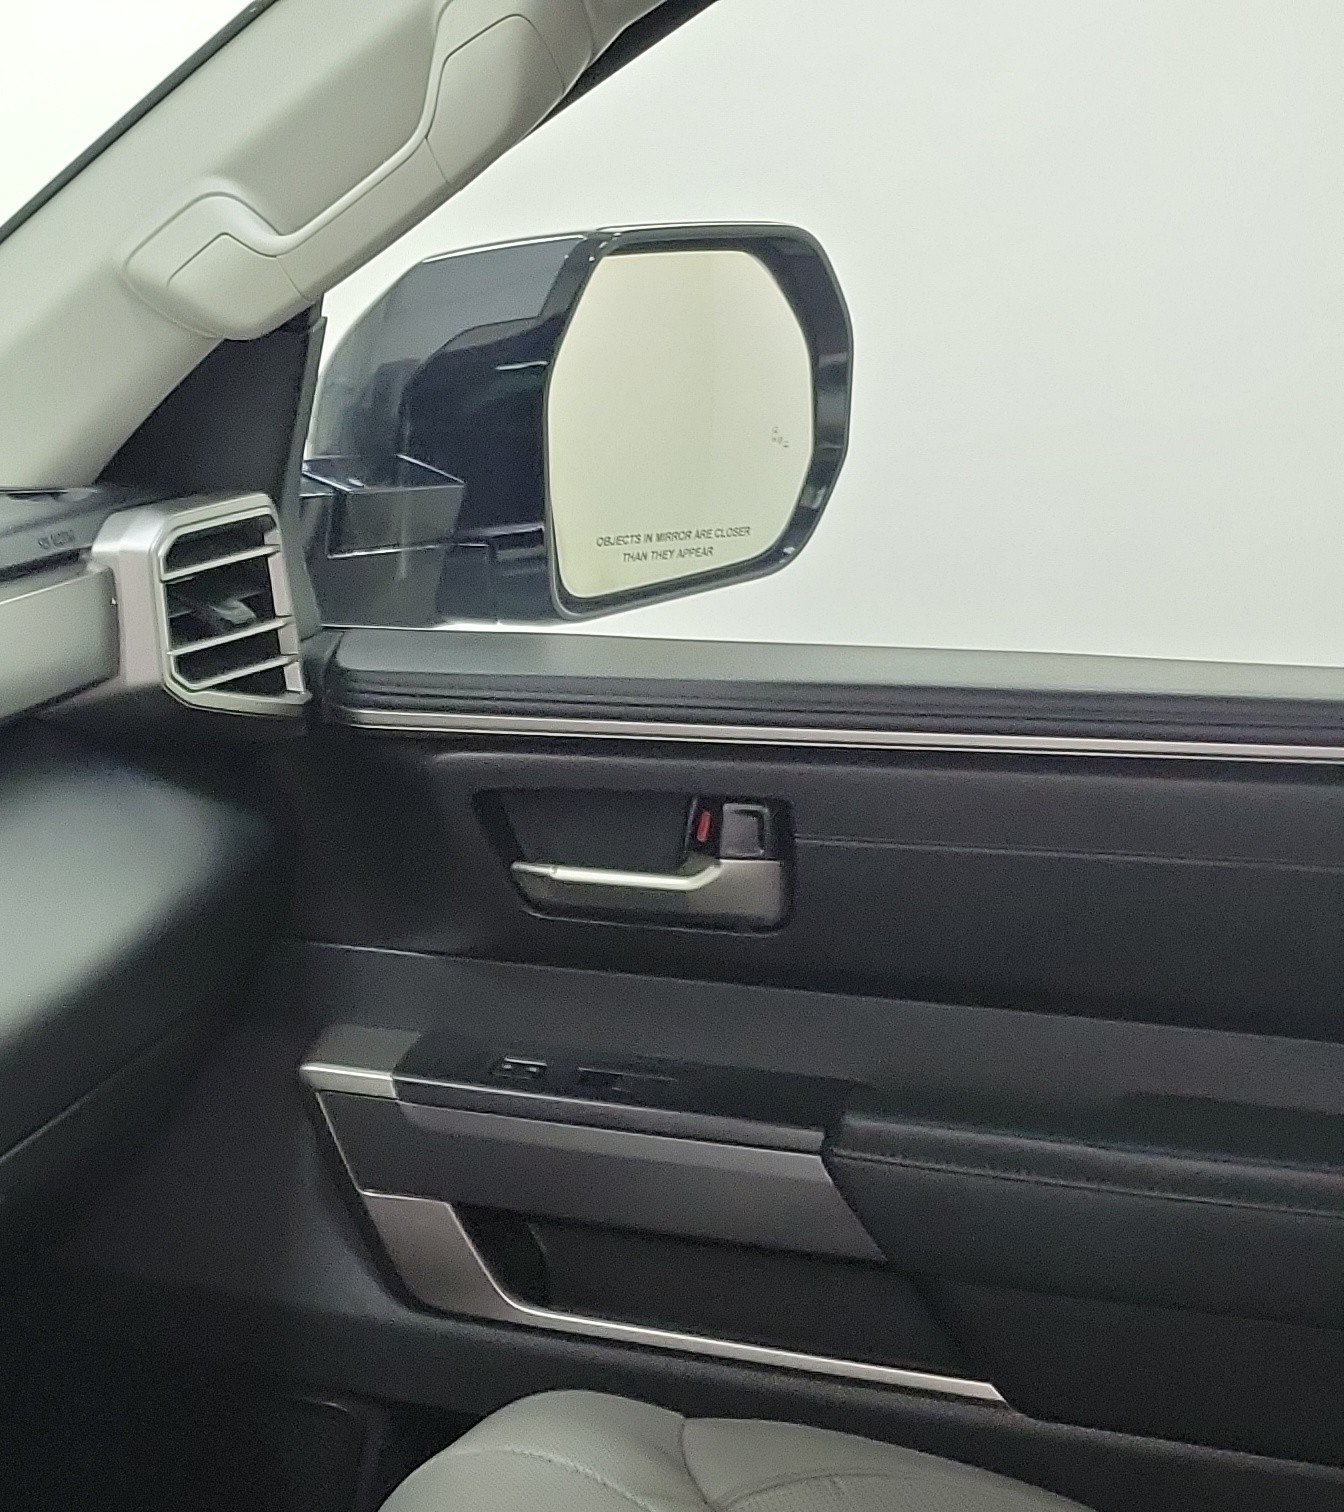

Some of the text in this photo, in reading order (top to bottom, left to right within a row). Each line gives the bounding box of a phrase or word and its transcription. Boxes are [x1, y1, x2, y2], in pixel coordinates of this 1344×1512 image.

[596, 526, 751, 548] OBJECTS IN MIRROR ARE CLOSER
[622, 547, 714, 562] THAN THEY APPEAR
